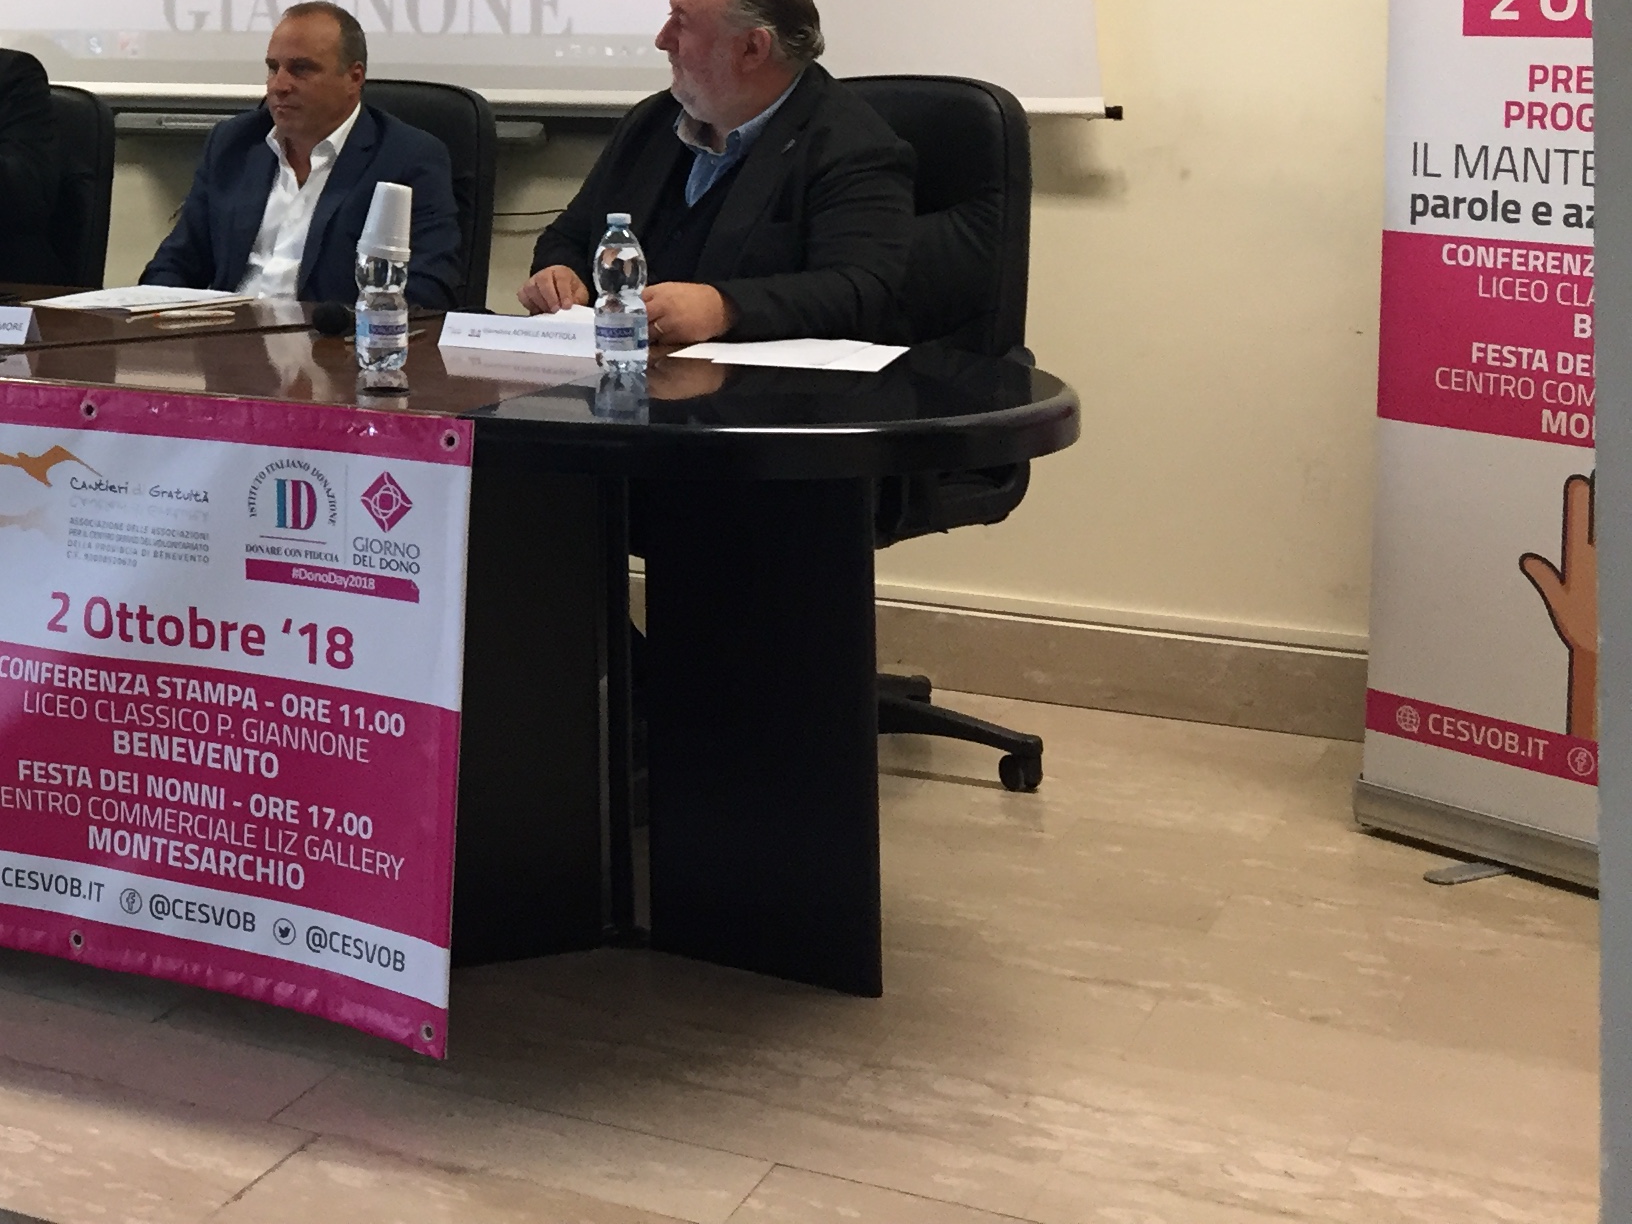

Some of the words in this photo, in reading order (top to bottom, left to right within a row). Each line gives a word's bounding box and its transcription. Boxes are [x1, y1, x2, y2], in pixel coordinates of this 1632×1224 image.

[1412, 141, 1442, 178] IL
[1410, 190, 1522, 225] parole
[1531, 201, 1553, 226] e
[1478, 275, 1549, 304] LICEO
[1471, 341, 1549, 372] FESTA
[1435, 366, 1535, 400] CENTRO
[1541, 409, 1596, 441] MO
[247, 471, 267, 518] ISTITUTO
[265, 458, 310, 475] ITALIANO
[310, 467, 337, 527] DONAZIONE
[69, 517, 124, 531] ASSOCIAZIONE
[126, 523, 148, 534] DELLE
[151, 527, 210, 541] ASSOCIAZIONI
[67, 540, 92, 549] DELLA
[153, 550, 210, 564] BENEVENTO
[245, 543, 282, 556] DONARE
[284, 547, 302, 558] CON
[304, 550, 339, 563] FIDUCIA
[352, 536, 420, 560] GIORNO
[352, 553, 376, 568] DEL
[379, 558, 420, 576] DONO
[291, 567, 376, 590] #DonoDay2018
[47, 592, 69, 634] 2
[83, 595, 266, 657] Ottobre
[156, 676, 257, 711] STAMPA
[282, 693, 331, 723] ORE
[339, 701, 405, 738] 11.00
[23, 691, 87, 721] LICEO
[94, 698, 210, 735] CLASSICO
[216, 712, 236, 739] P.
[242, 718, 370, 763] GIANNONE
[1428, 713, 1549, 761] CESVOB.IT
[113, 731, 279, 779] BENEVENTO
[17, 759, 93, 789] FESTA
[100, 769, 139, 796] DEI
[146, 775, 225, 811] NONNI
[249, 792, 299, 824] ORE
[307, 803, 373, 840] 17.00
[87, 794, 257, 849] COMMERCIALE
[264, 823, 296, 855] LIZ
[304, 832, 405, 881] GALLERY
[88, 825, 305, 891] MONTESARCHIO
[2, 866, 105, 904] CESVOB.IT
[149, 893, 256, 934] @CESVOB
[306, 925, 406, 973] @CESVOB
